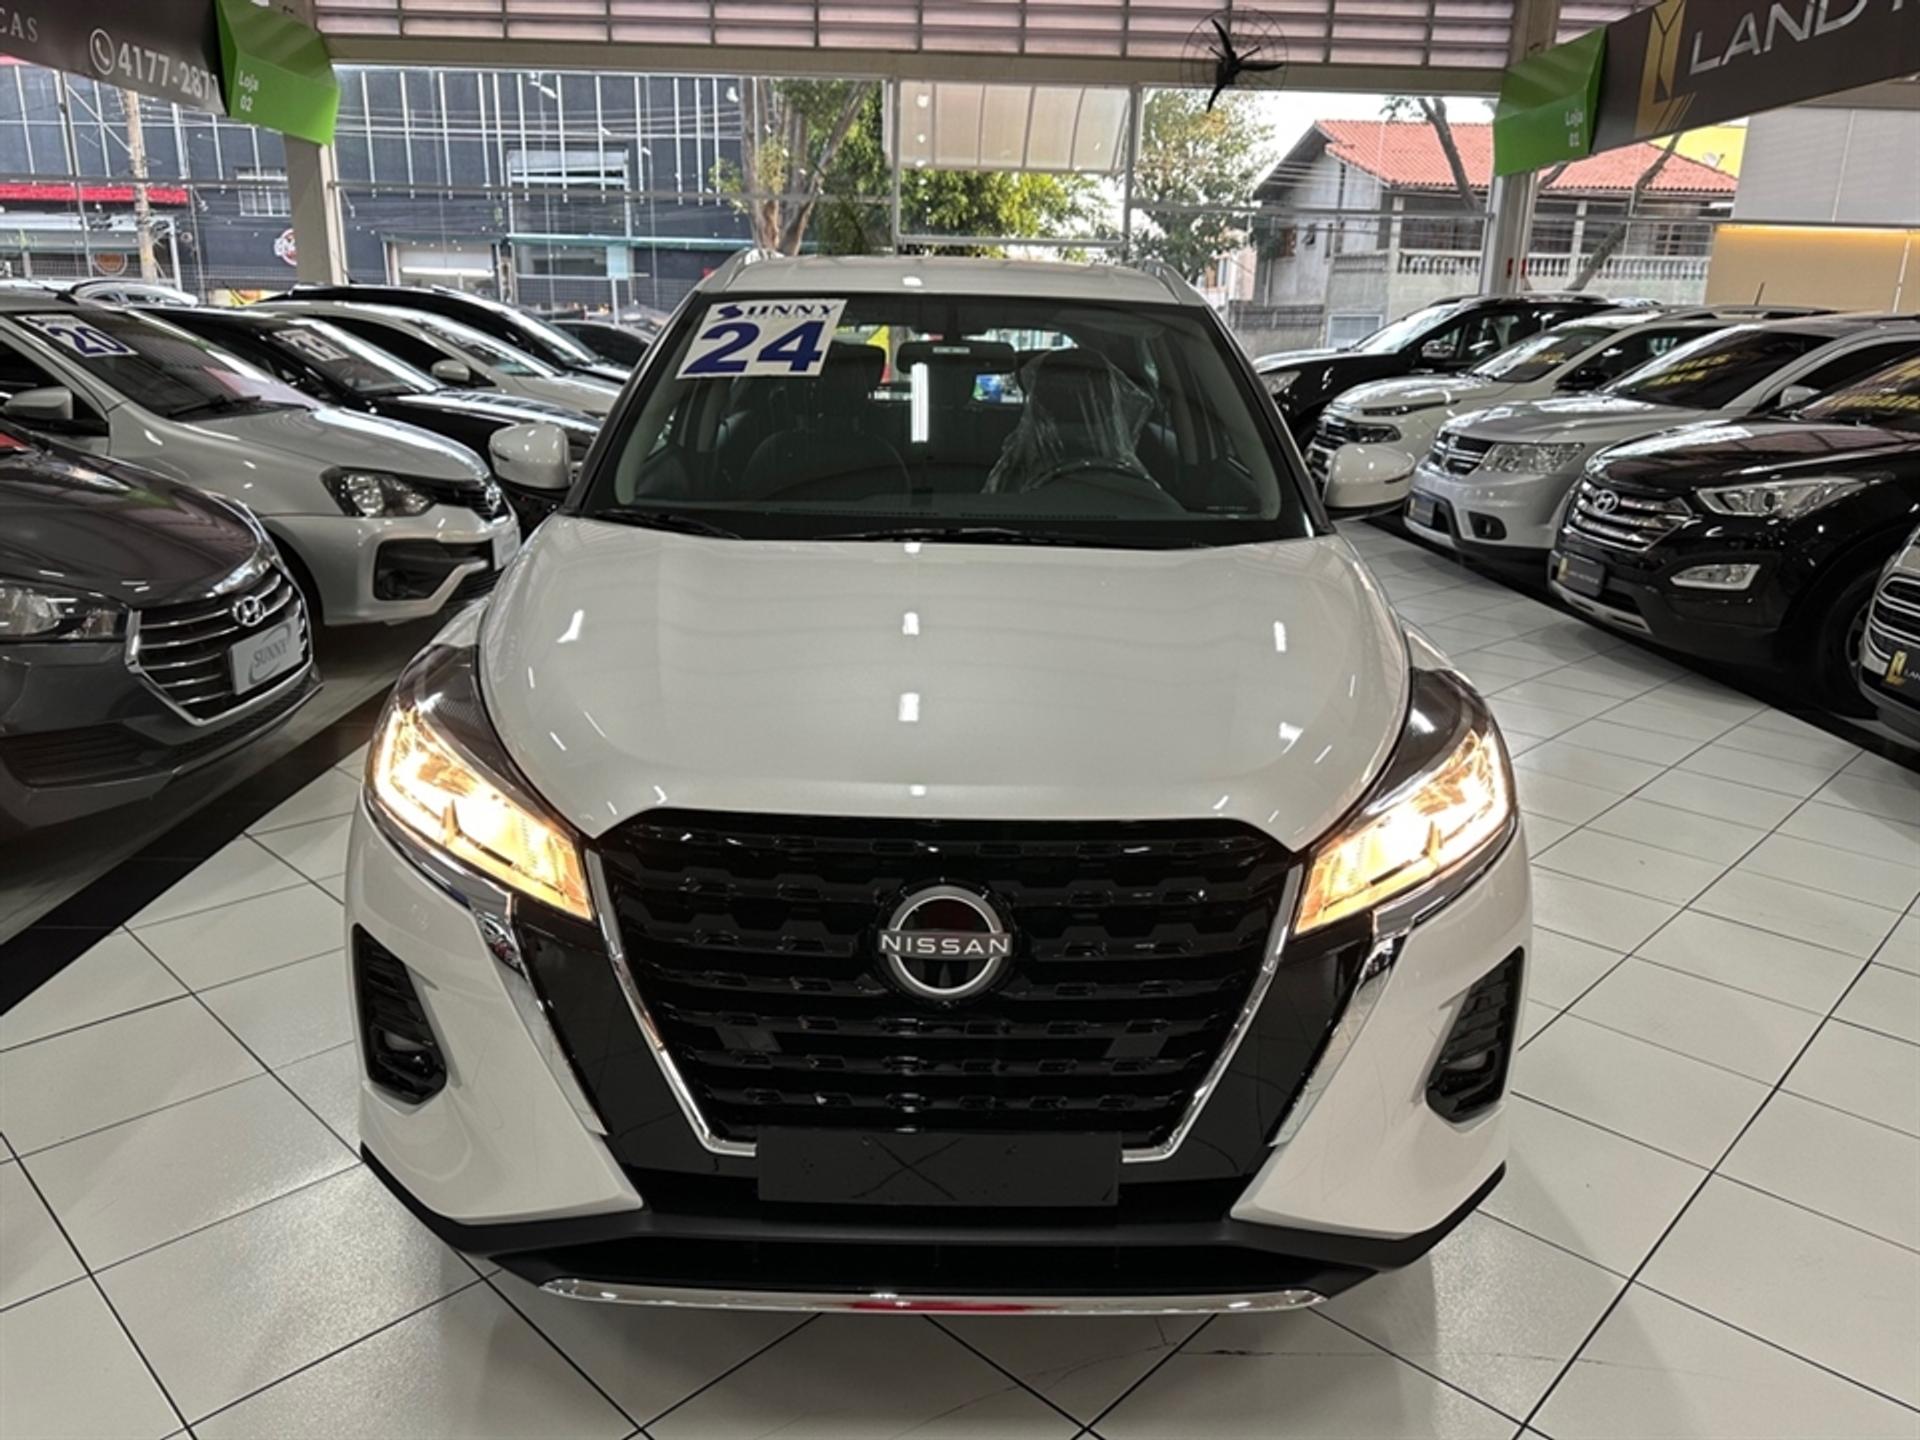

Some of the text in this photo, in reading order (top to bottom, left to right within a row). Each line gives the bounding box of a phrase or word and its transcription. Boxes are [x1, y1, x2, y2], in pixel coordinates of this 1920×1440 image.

[239, 70, 259, 93] Loja
[710, 304, 837, 322] SUNNY
[682, 320, 825, 375] 24
[881, 934, 1008, 955] NISSAN
